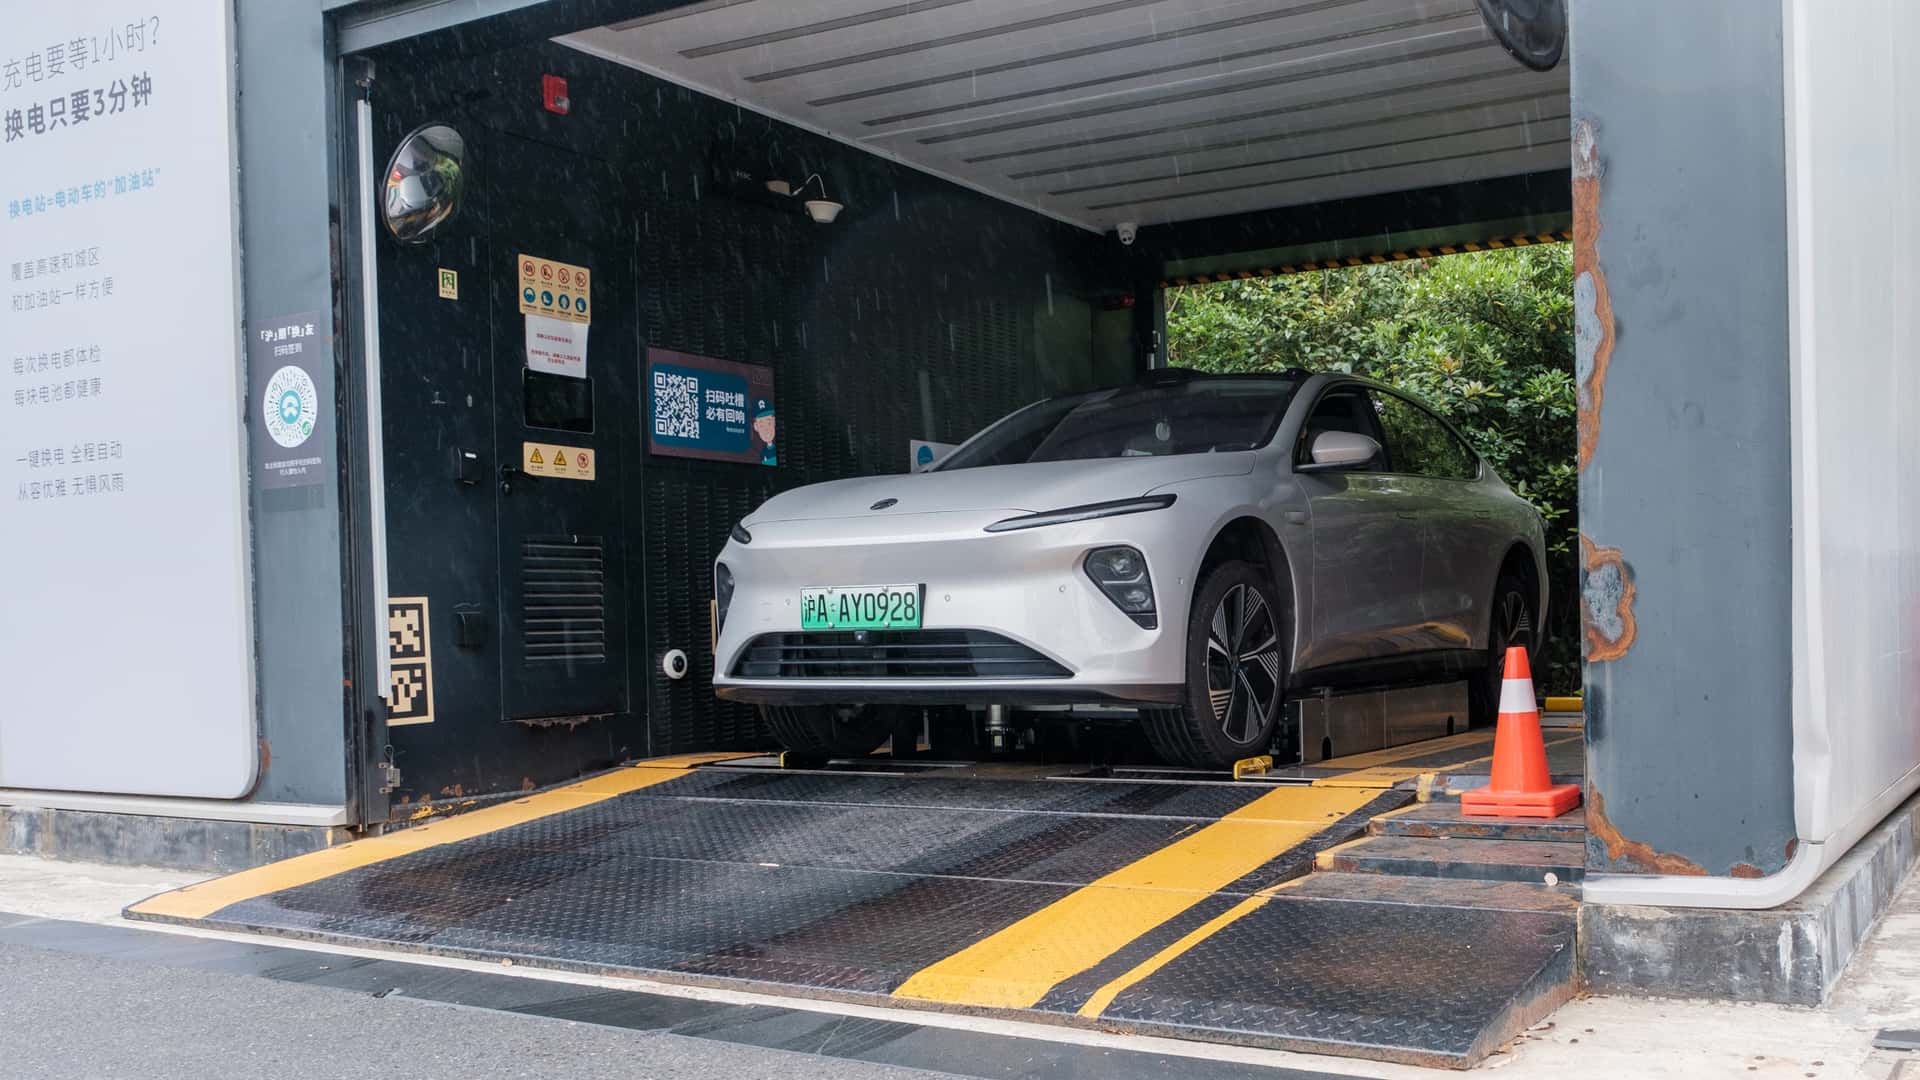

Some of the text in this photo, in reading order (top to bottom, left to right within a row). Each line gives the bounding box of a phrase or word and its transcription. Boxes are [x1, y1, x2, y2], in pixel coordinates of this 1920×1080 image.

[4, 71, 152, 143] 换电只要3分钟
[11, 246, 100, 281] 覆盖高速和城区
[12, 276, 113, 312] 和加油站一样方便
[14, 345, 101, 375] 每次换电都体检
[14, 377, 102, 407] 每块电池都健康
[705, 388, 745, 408] 扫码吐槽
[705, 406, 745, 424] 必有回响
[16, 440, 123, 469] 一键换电 全程自动
[17, 472, 124, 501] 从容优雅 无惧风雨
[839, 592, 916, 622] AY0928
